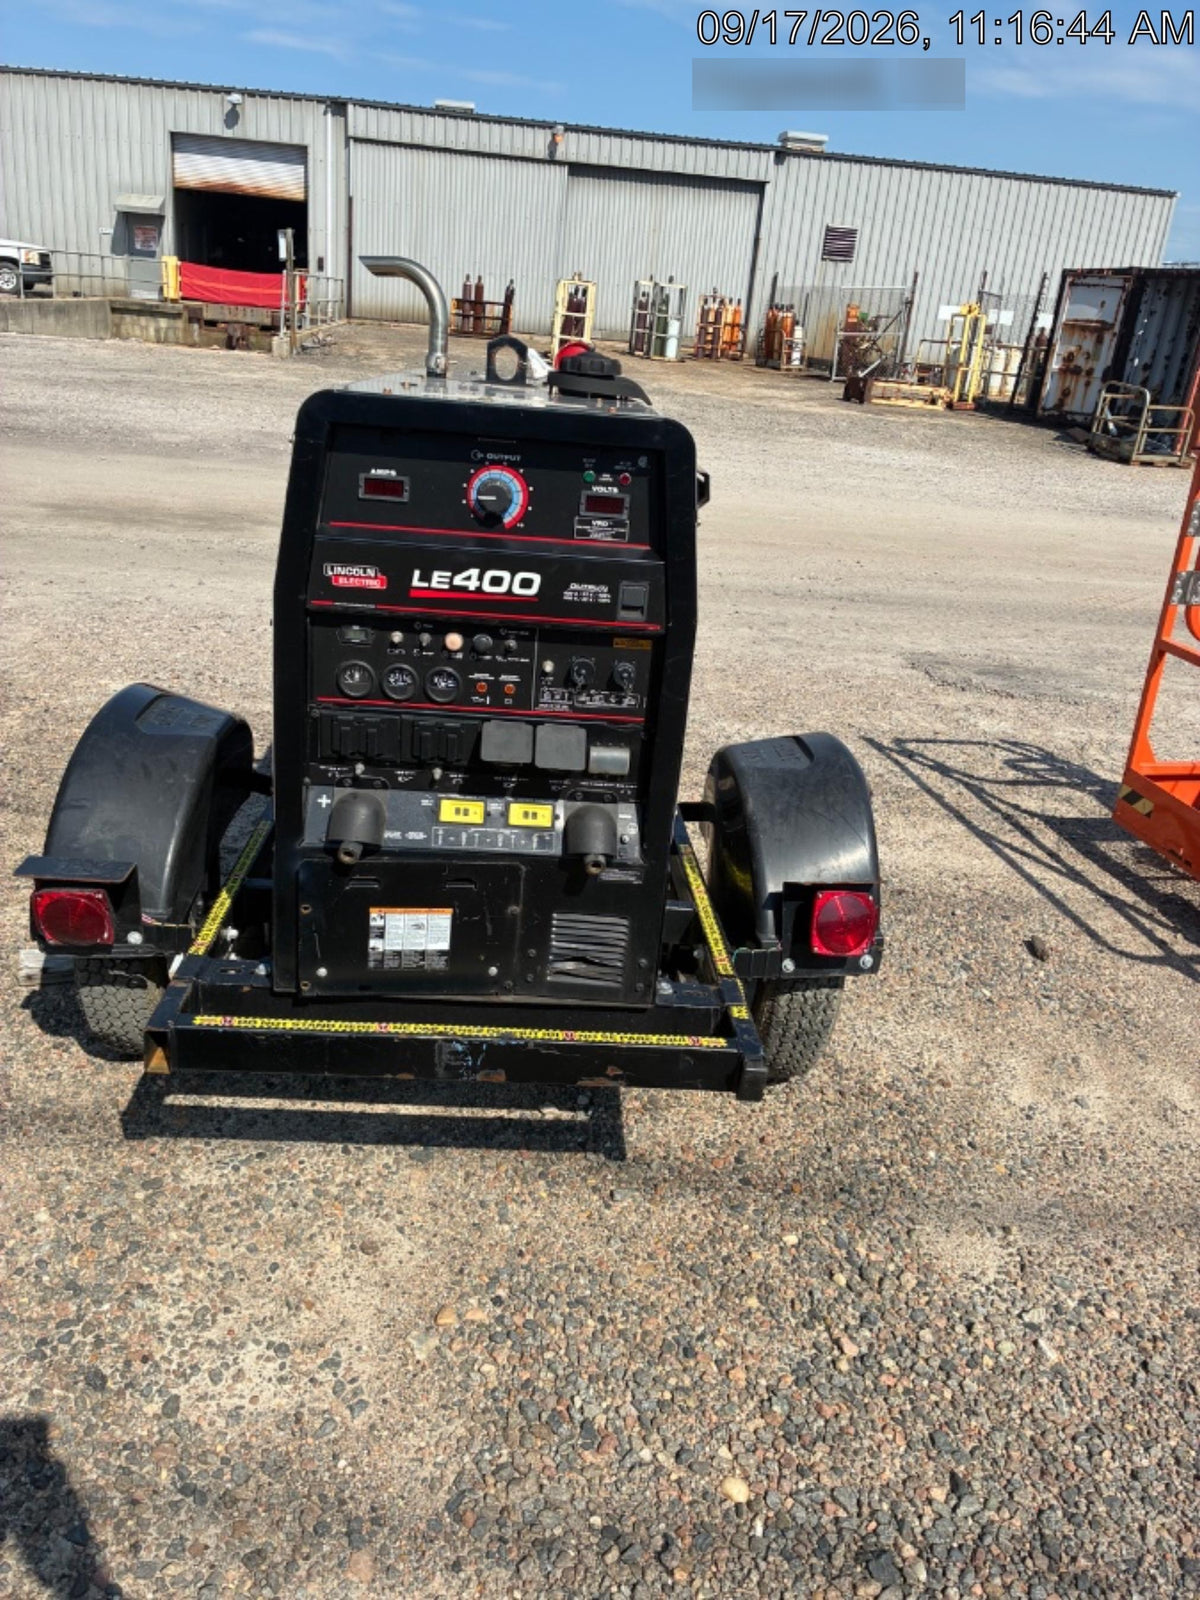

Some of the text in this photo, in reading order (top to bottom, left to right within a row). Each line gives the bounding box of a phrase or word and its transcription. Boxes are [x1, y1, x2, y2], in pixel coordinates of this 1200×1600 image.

[486, 452, 522, 462] OUTPUT
[370, 468, 397, 477] AMPS
[591, 485, 619, 494] VOLTS
[326, 565, 376, 578] LINCOLN
[338, 576, 381, 588] ELECTRIC
[410, 567, 542, 597] LE400
